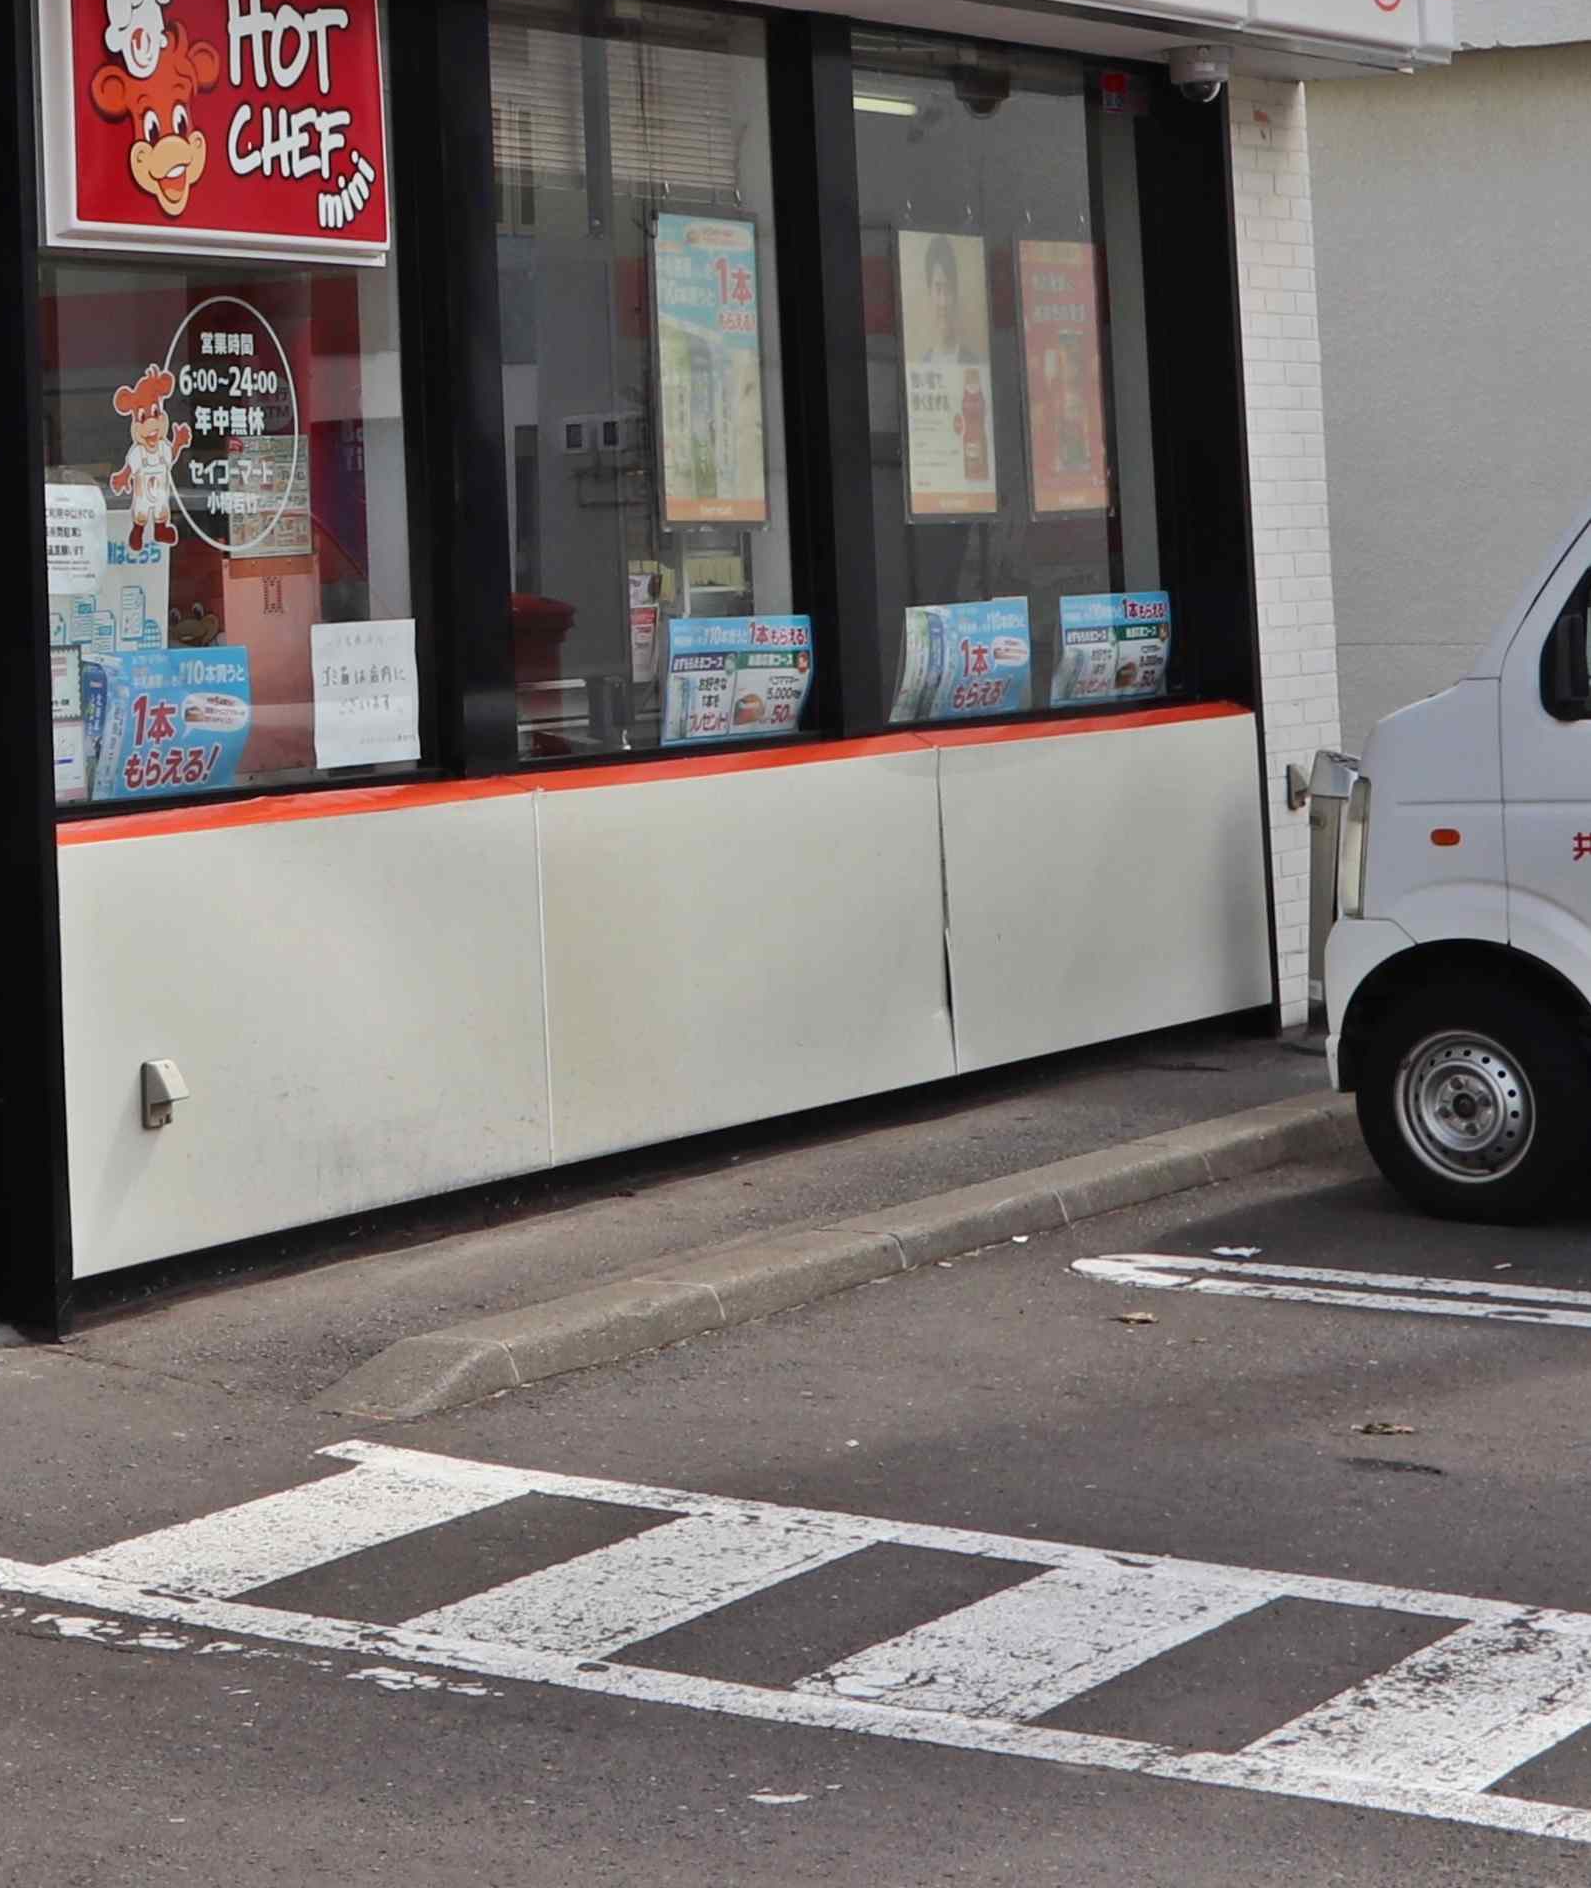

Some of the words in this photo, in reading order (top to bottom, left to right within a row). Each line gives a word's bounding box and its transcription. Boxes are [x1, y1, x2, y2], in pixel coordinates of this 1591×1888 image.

[227, 103, 351, 181] CHEF
[319, 150, 376, 229] mini
[200, 331, 254, 356] 営業時間
[194, 405, 265, 436] 年中無休
[188, 459, 274, 485] セイコーマート
[960, 638, 989, 677] 1本
[132, 695, 177, 746] 1本
[123, 744, 221, 791] もらえる!
